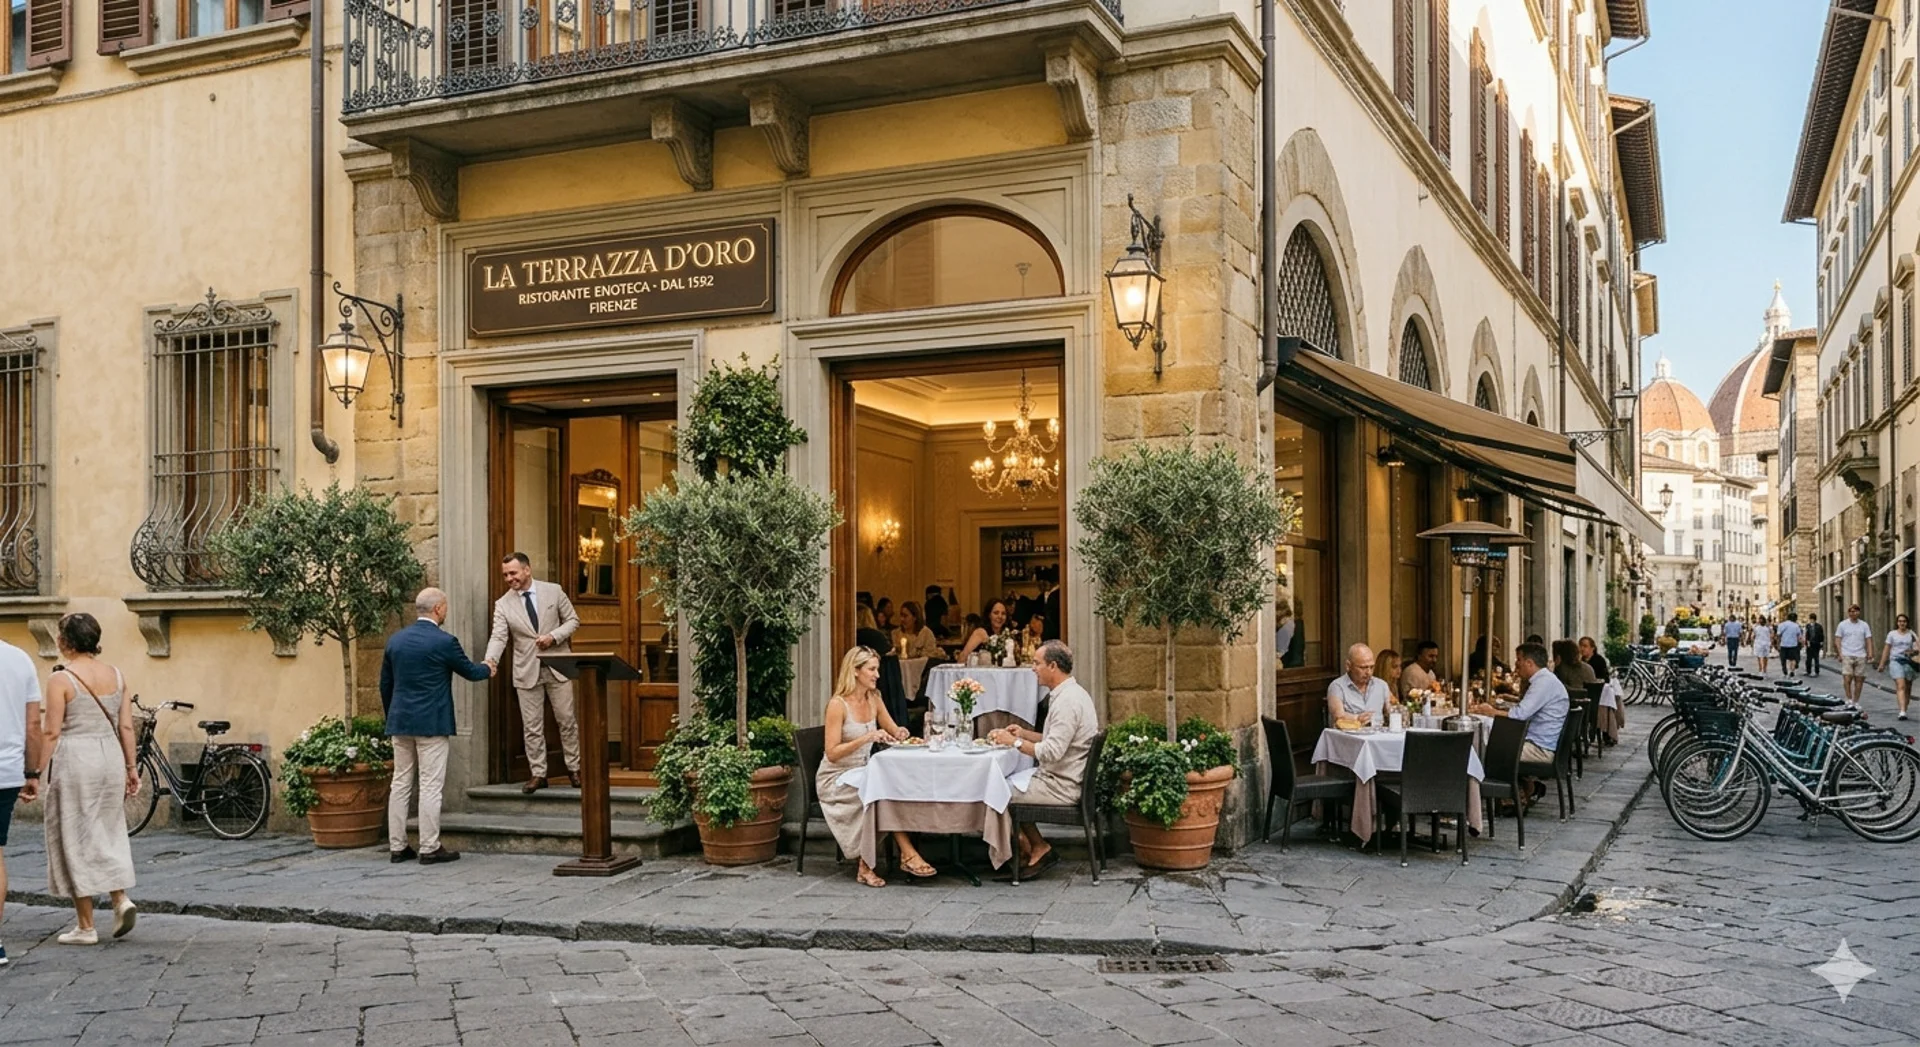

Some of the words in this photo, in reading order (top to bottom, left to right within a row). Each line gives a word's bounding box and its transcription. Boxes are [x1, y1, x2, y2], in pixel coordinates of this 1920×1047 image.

[483, 263, 517, 291] LA
[521, 248, 658, 286] TERRAZZA
[664, 237, 756, 271] D’ORO
[518, 287, 591, 305] RISTORANTE
[594, 281, 651, 298] ENOTECA
[660, 277, 685, 291] DAL
[589, 298, 638, 314] FIRENZE
